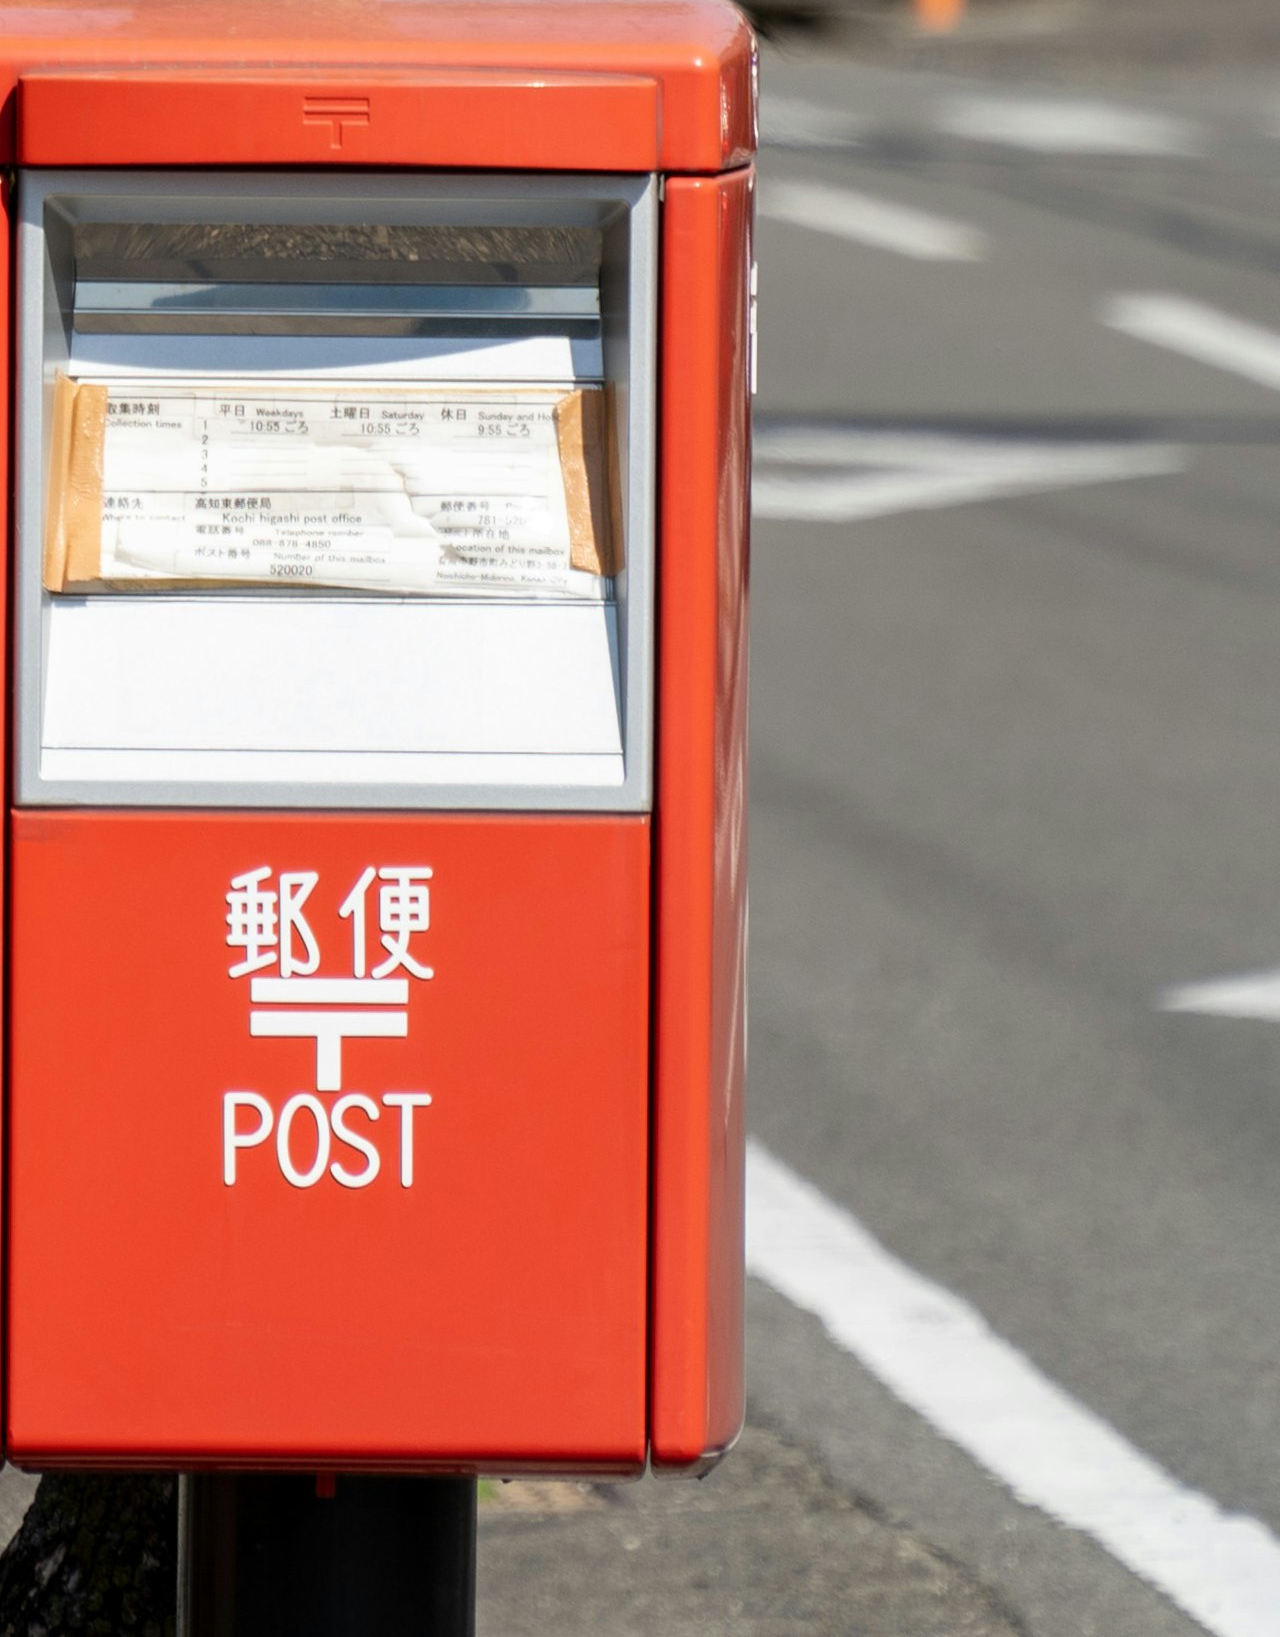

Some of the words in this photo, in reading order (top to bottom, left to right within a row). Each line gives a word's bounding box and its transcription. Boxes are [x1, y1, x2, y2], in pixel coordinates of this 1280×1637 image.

[106, 403, 160, 416] 取集時刻
[219, 404, 246, 417] 平日
[256, 408, 305, 419] Weekdays
[330, 406, 370, 420] 土曜日
[381, 409, 425, 421] Saturday
[441, 407, 467, 421] 休日
[478, 411, 513, 423] Sunday
[517, 411, 535, 422] and
[155, 420, 182, 429] times
[250, 421, 280, 432] 10:55
[285, 420, 309, 434] ごろ
[360, 423, 391, 435] 10:55
[395, 422, 420, 437] ごろ
[478, 424, 502, 436] 9:55
[507, 423, 531, 437] ごろ
[201, 435, 209, 445] 2
[201, 449, 208, 460] 3
[201, 463, 208, 473] 4
[201, 477, 208, 488] 5
[195, 497, 272, 510] 高知東郵便局
[441, 501, 489, 512] 郵便番号
[222, 513, 256, 524] Kochi
[259, 513, 300, 526] higashi
[303, 514, 329, 526] post
[332, 513, 363, 524] office
[494, 545, 505, 554] of
[508, 545, 525, 555] this
[314, 553, 325, 563] of
[328, 553, 346, 563] this
[269, 564, 313, 576] 520020
[225, 864, 434, 980] 郵便
[222, 1091, 433, 1190] POST
